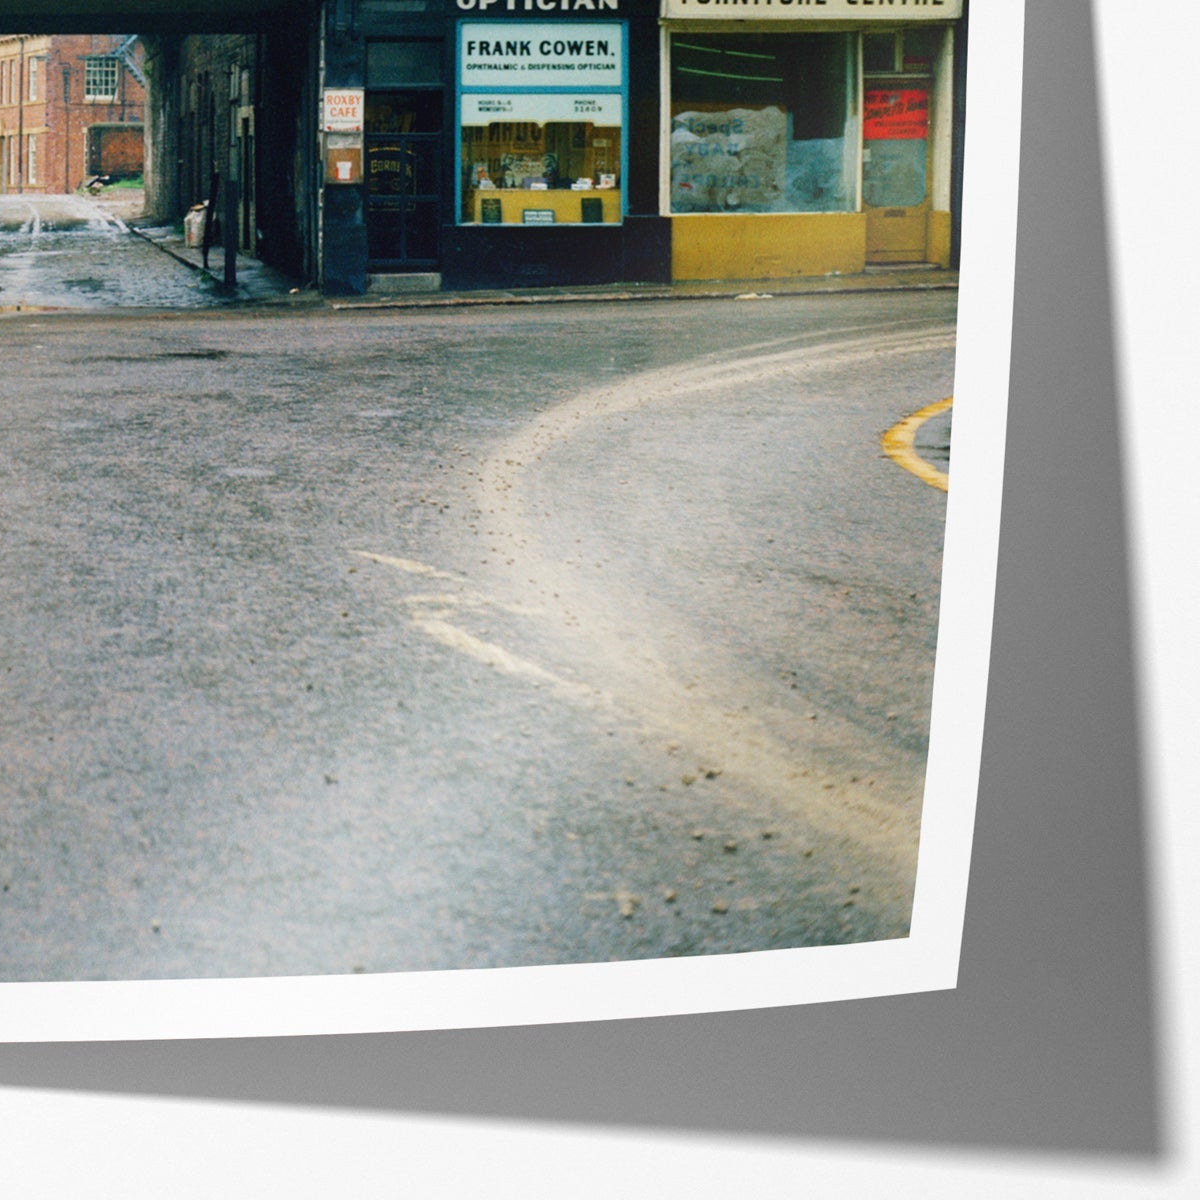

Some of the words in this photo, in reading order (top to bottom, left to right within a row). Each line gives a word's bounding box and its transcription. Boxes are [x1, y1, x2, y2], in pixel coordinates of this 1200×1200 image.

[467, 40, 531, 56] FRANK
[539, 40, 615, 57] COWEN.
[528, 63, 576, 71] DISPENSING
[577, 63, 616, 71] OPTICIAN
[326, 94, 362, 105] ROXBY
[329, 106, 358, 117] CAFE
